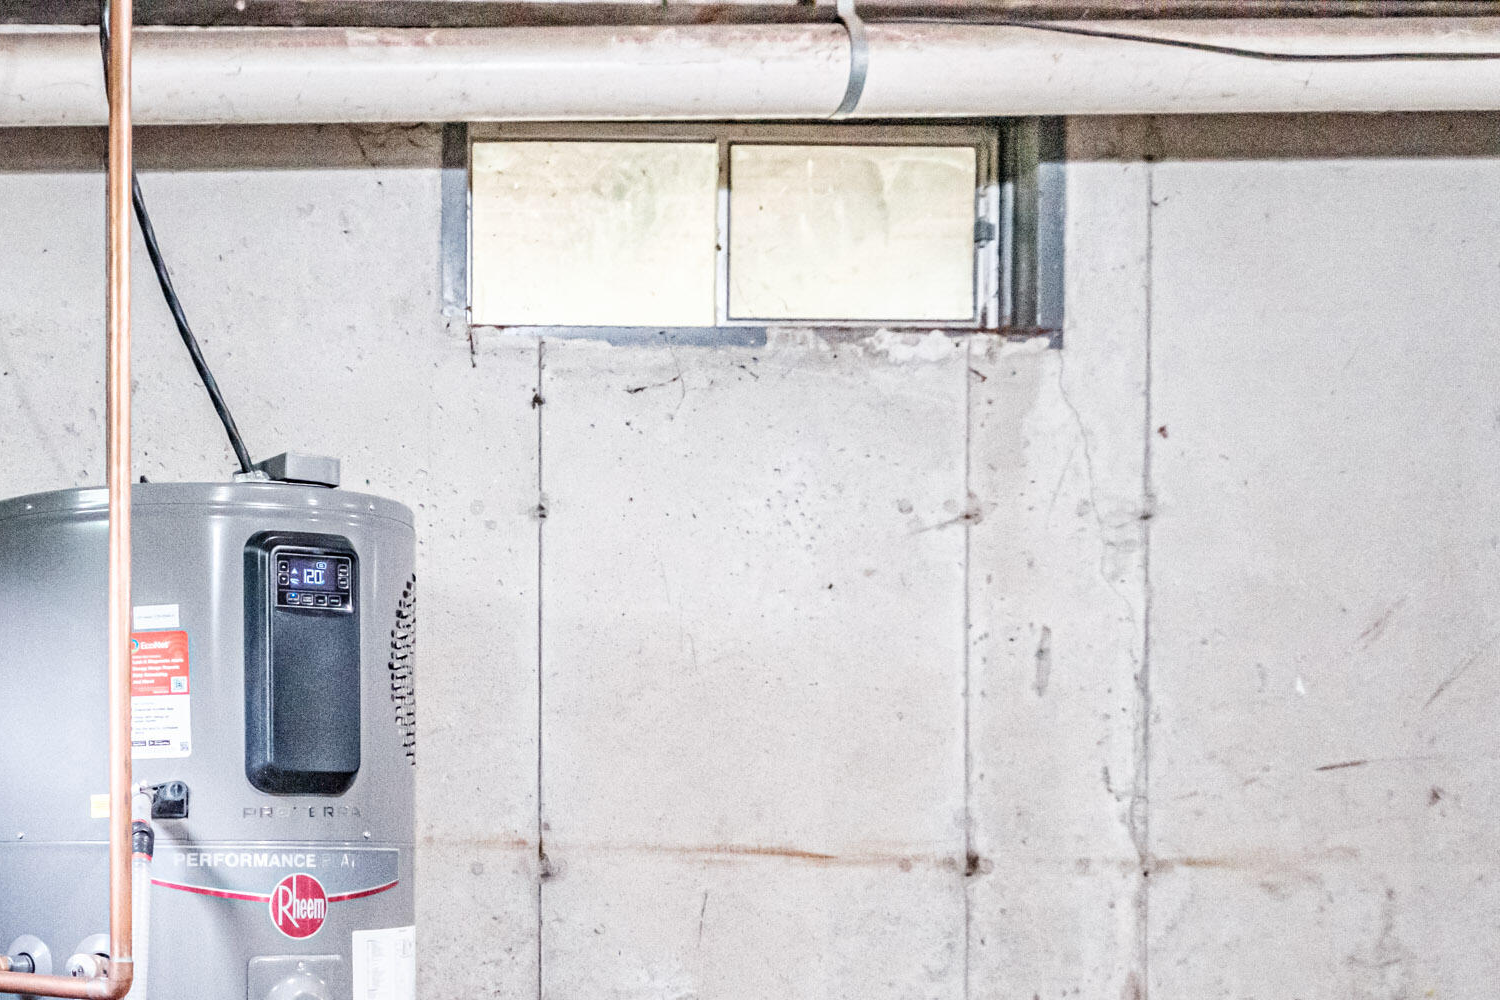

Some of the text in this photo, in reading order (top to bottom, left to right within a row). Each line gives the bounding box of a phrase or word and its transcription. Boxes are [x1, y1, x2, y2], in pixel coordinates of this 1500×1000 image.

[243, 806, 361, 818] PROERRA
[172, 852, 316, 868] PERFORMANCE
[278, 873, 325, 929] Rheem
